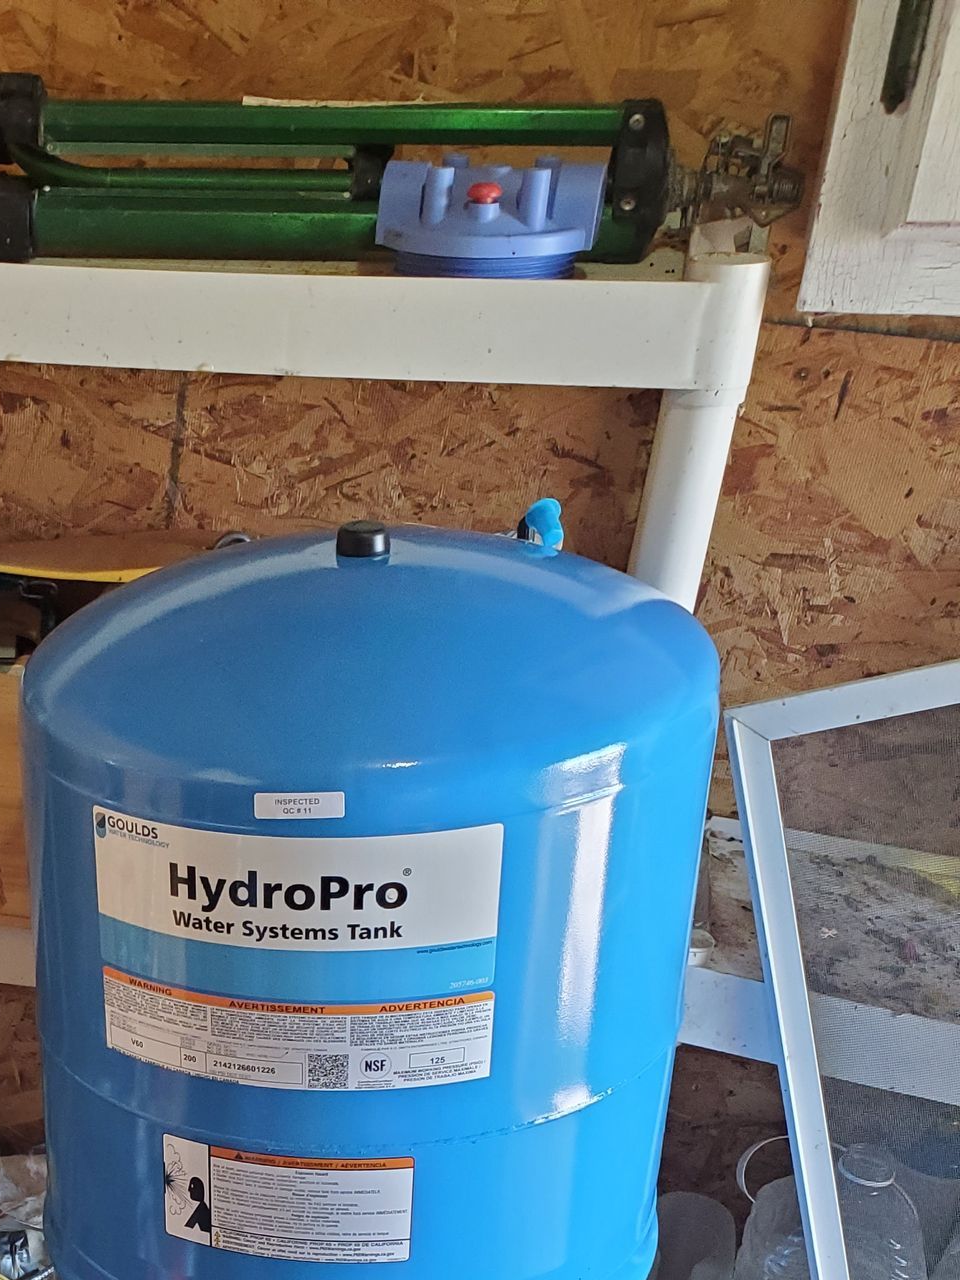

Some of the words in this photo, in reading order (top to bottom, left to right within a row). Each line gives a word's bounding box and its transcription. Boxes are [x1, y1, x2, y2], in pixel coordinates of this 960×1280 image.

[107, 815, 158, 839] GOULDS
[108, 829, 127, 838] WATER
[127, 834, 170, 849] TECHNOLOGY
[169, 862, 408, 912] HydroPro
[172, 910, 234, 934] Water
[242, 920, 339, 941] Systems
[347, 921, 403, 940] Tank
[129, 977, 172, 996] WARNING
[229, 1000, 325, 1014] AVERTISSEMENT
[379, 997, 465, 1013] ADVERTENCIA
[131, 1037, 144, 1048] V60
[183, 1053, 197, 1063] 200
[430, 1056, 446, 1064] 125
[213, 1060, 276, 1074] 2142126601226
[364, 1059, 387, 1073] NSF
